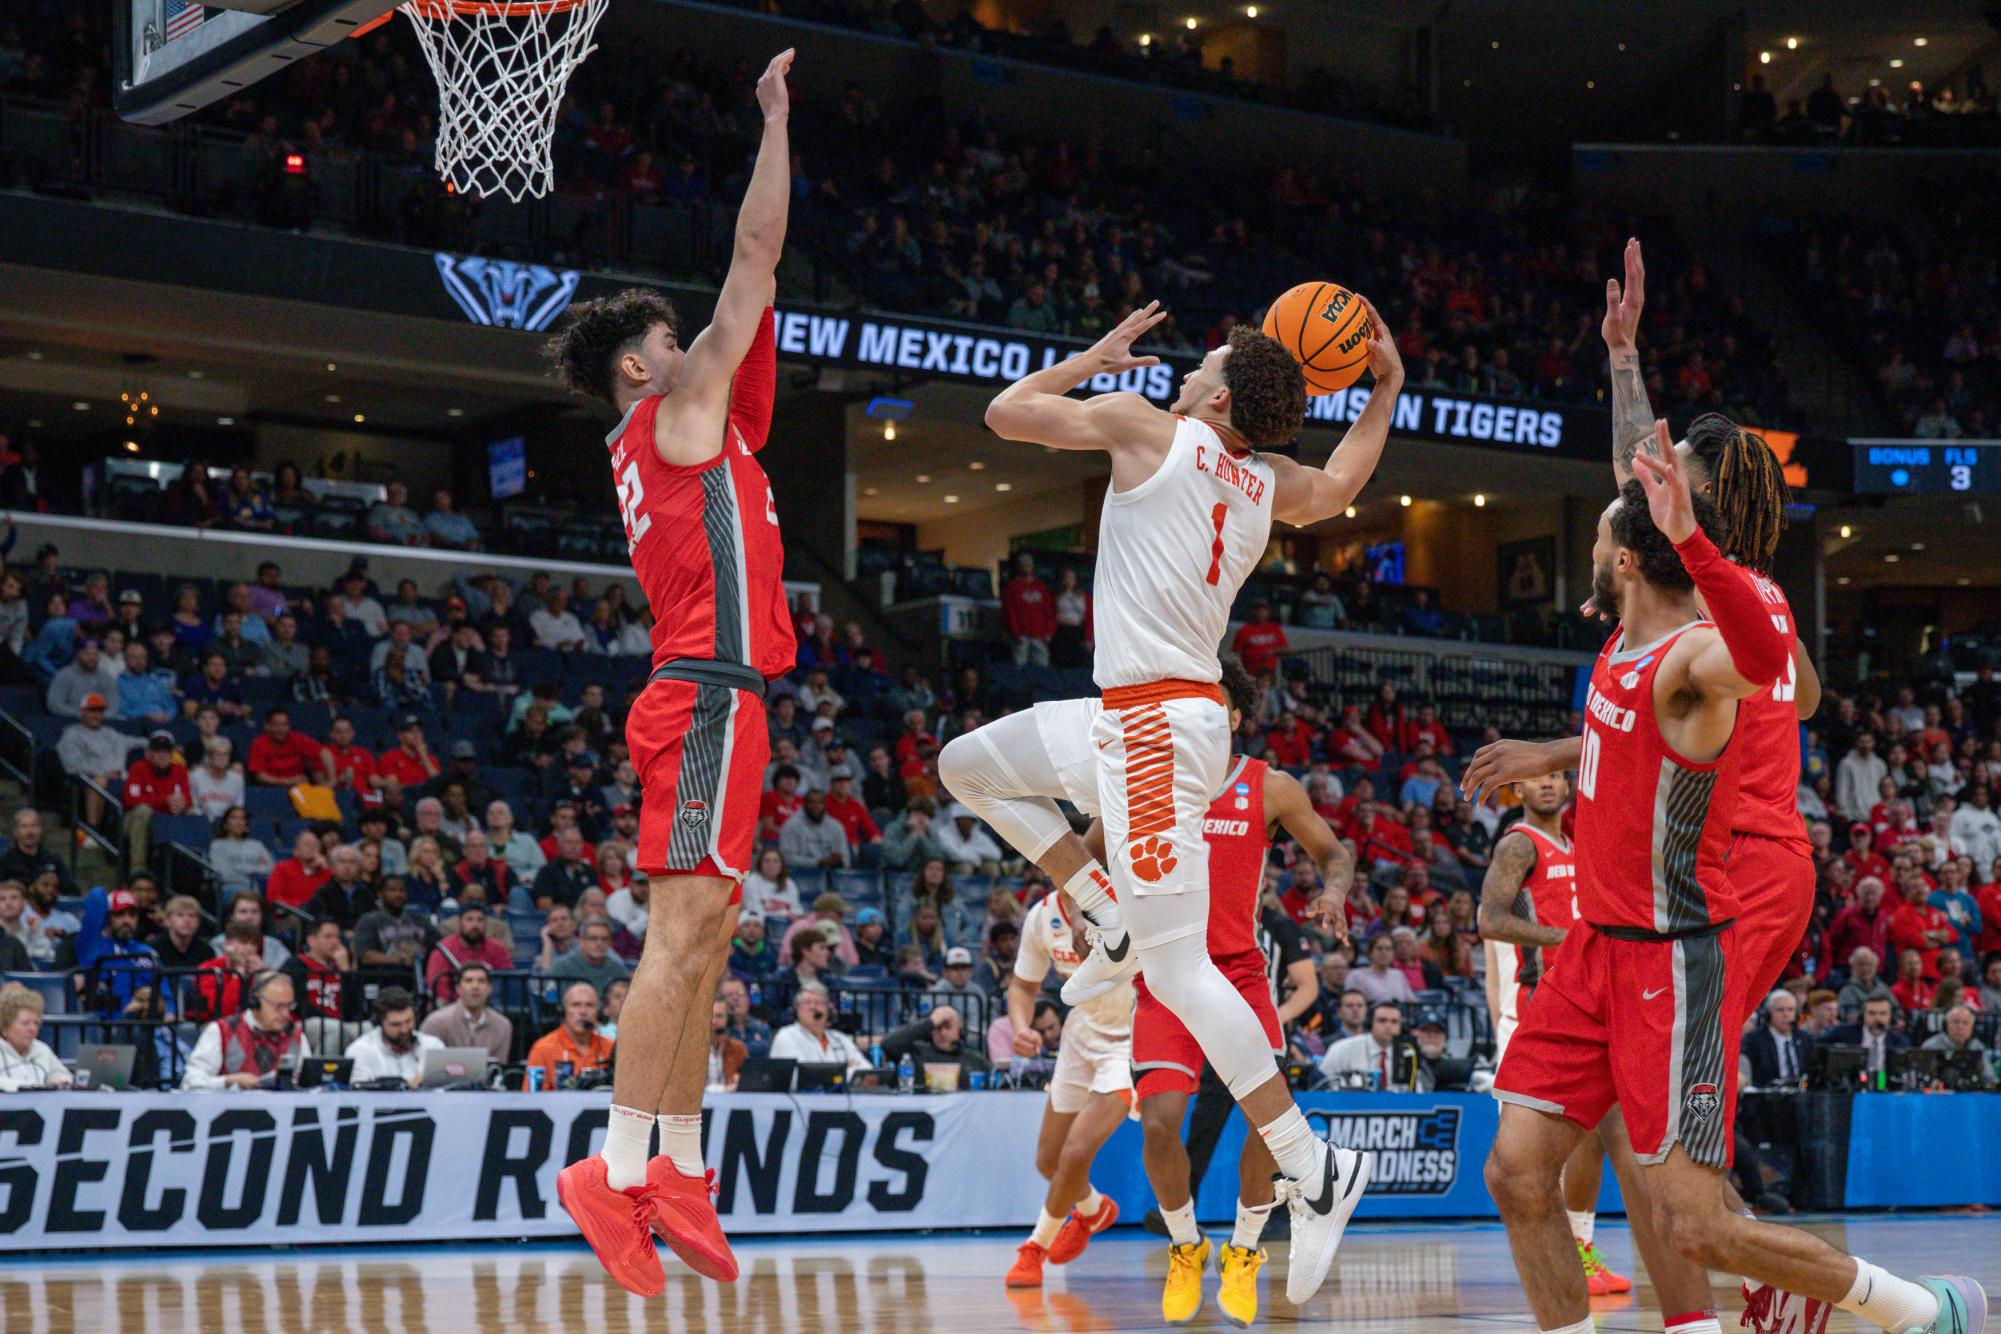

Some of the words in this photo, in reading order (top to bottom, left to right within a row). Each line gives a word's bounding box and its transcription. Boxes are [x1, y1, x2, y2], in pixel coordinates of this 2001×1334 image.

[858, 323, 1030, 380] MEXICO
[1432, 398, 1563, 448] TIGERS
[1196, 446, 1209, 472] C.
[1215, 453, 1265, 507] HUNTER
[1869, 448, 1930, 464] BONUS
[1945, 448, 1977, 464] FLS
[1951, 466, 1971, 490] 3
[1206, 502, 1228, 586] 1
[1590, 690, 1636, 733] MEXICO
[1578, 722, 1600, 800] 10
[1330, 1116, 1419, 1150] MARCH
[0, 1107, 437, 1234] SECOND
[473, 1108, 935, 1221] RNDS
[1370, 1150, 1456, 1184] ADNESS
